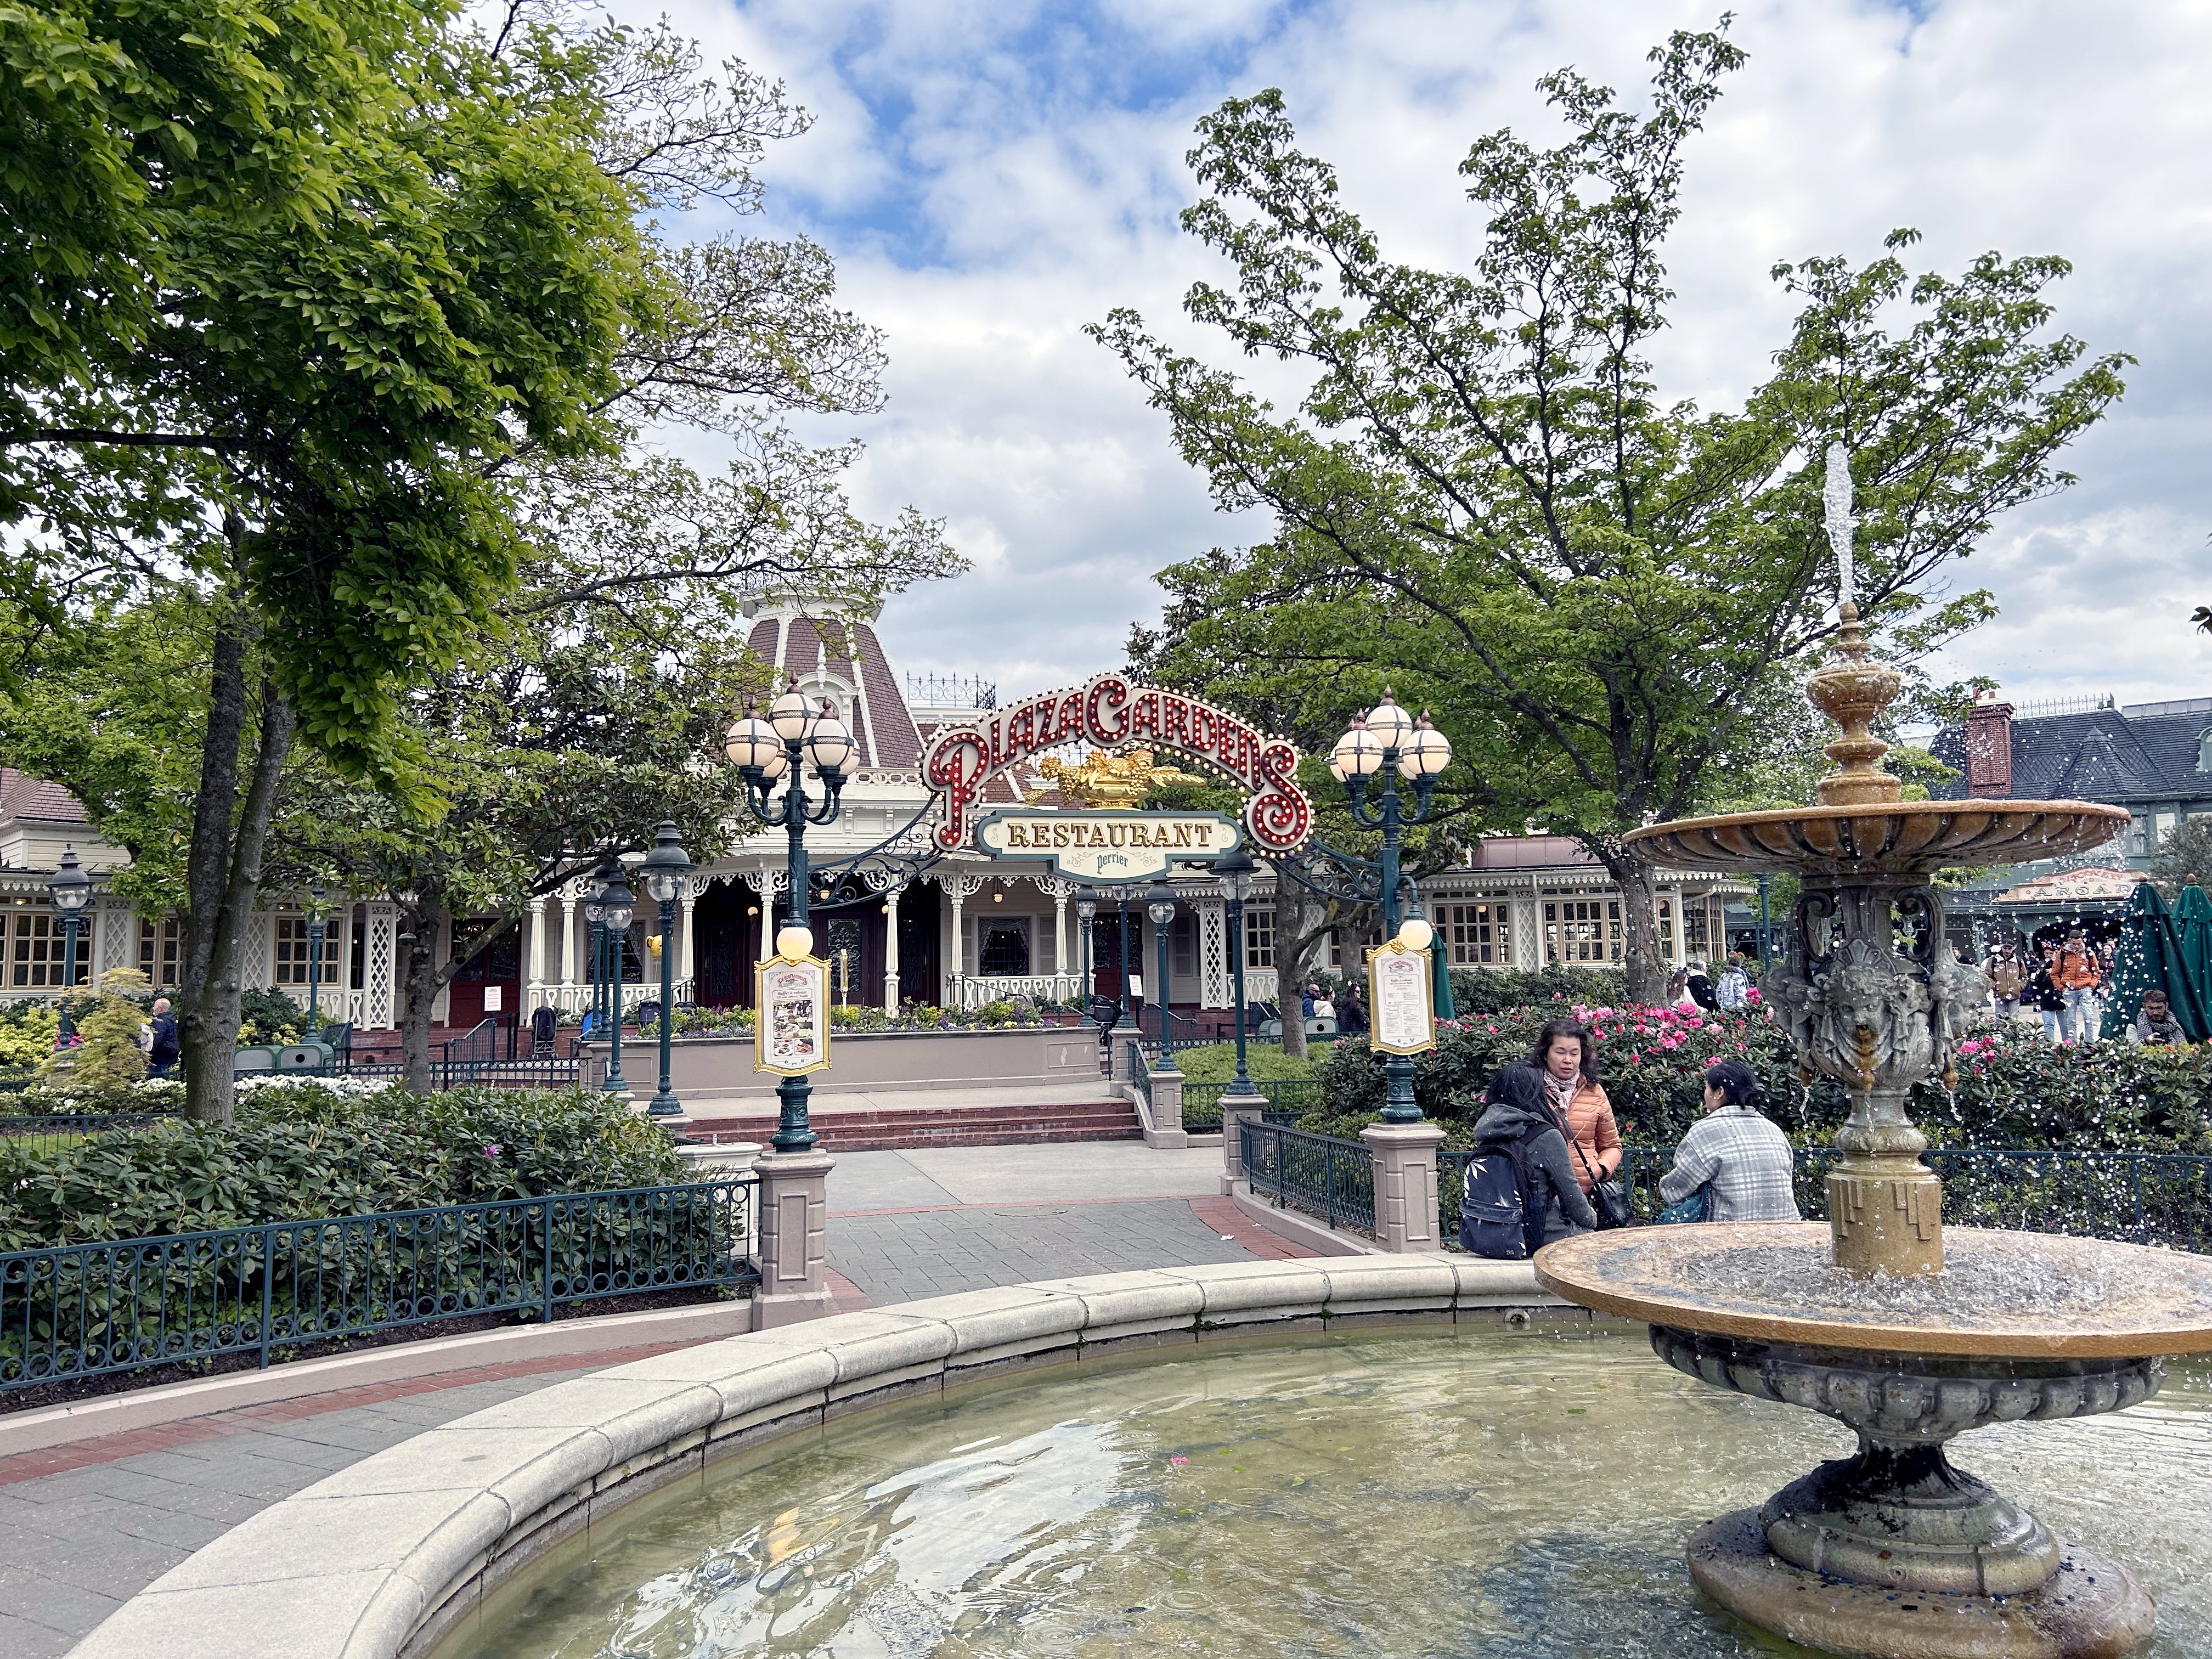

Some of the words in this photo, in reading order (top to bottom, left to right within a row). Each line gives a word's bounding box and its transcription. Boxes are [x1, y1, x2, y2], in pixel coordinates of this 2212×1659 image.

[1007, 823, 1212, 848] RESTAURANT
[1097, 851, 1128, 875] perrier
[2034, 883, 2132, 897] ARCAD
